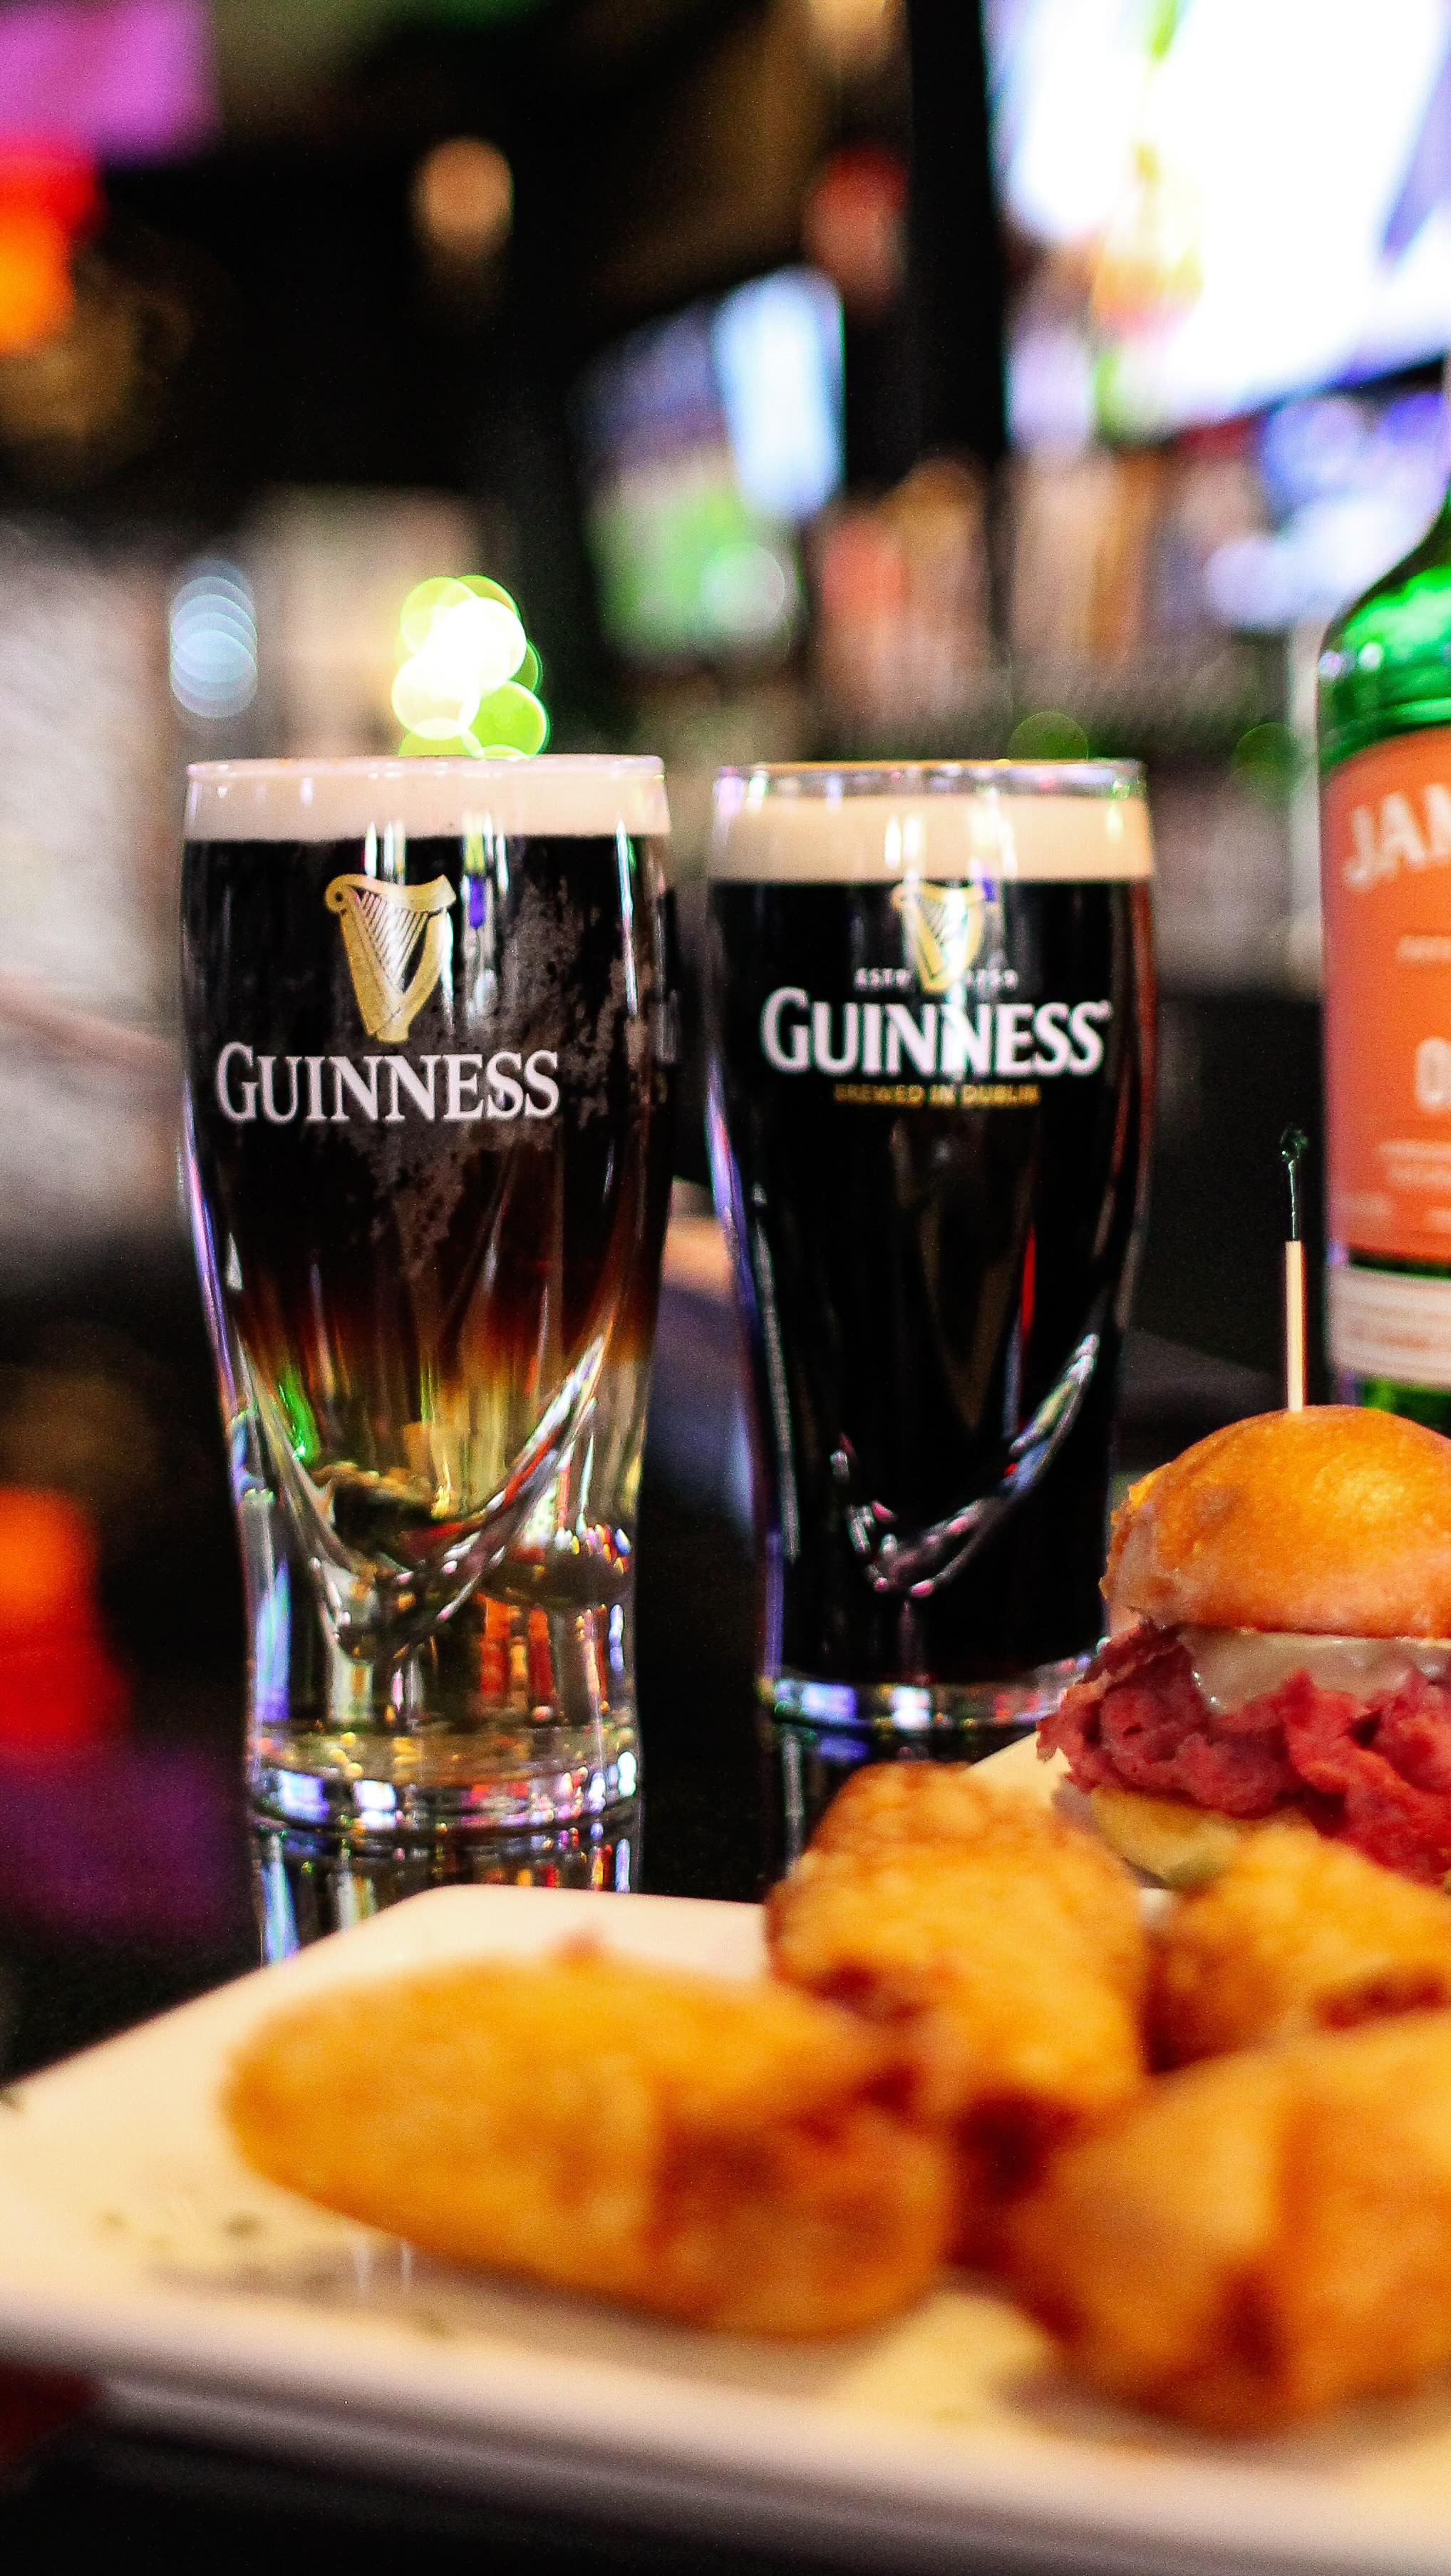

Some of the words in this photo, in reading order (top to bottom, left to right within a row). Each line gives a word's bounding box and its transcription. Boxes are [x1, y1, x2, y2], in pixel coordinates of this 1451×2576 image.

[760, 987, 1110, 1077] GUINNESS
[217, 1041, 560, 1123] GUINNESS
[835, 1084, 924, 1107] BREWED
[929, 1084, 955, 1107] IN
[962, 1084, 1039, 1107] DUBLIN
